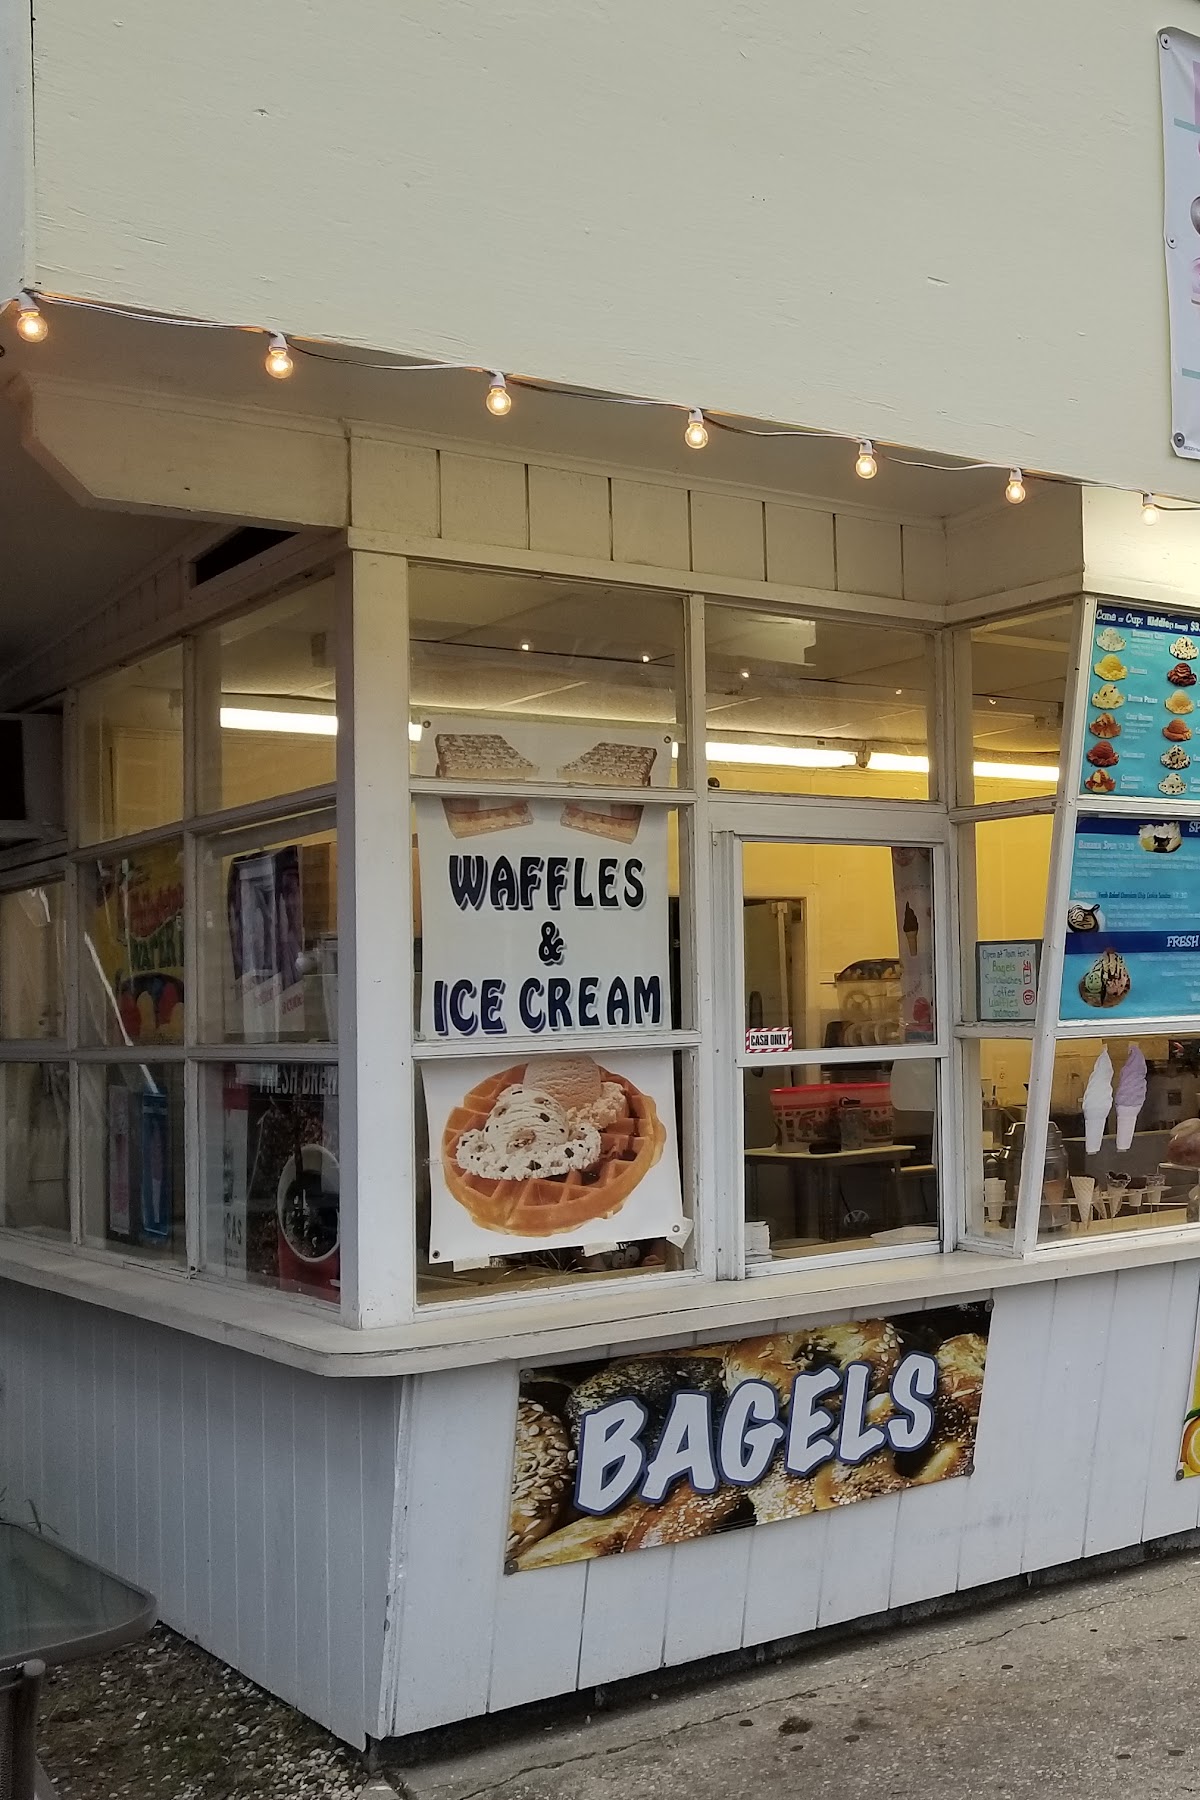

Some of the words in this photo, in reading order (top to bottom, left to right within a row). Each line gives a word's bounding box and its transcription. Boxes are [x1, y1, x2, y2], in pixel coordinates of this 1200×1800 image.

[449, 855, 645, 911] WAFFLES
[539, 921, 565, 966] &
[1167, 935, 1199, 948] FRESH
[992, 960, 1016, 974] Bagels
[433, 978, 506, 1036] ICE
[519, 976, 662, 1033] CREAM
[751, 1034, 769, 1047] CASH
[770, 1034, 787, 1046] ONLY
[573, 1351, 938, 1516] BAGELS
